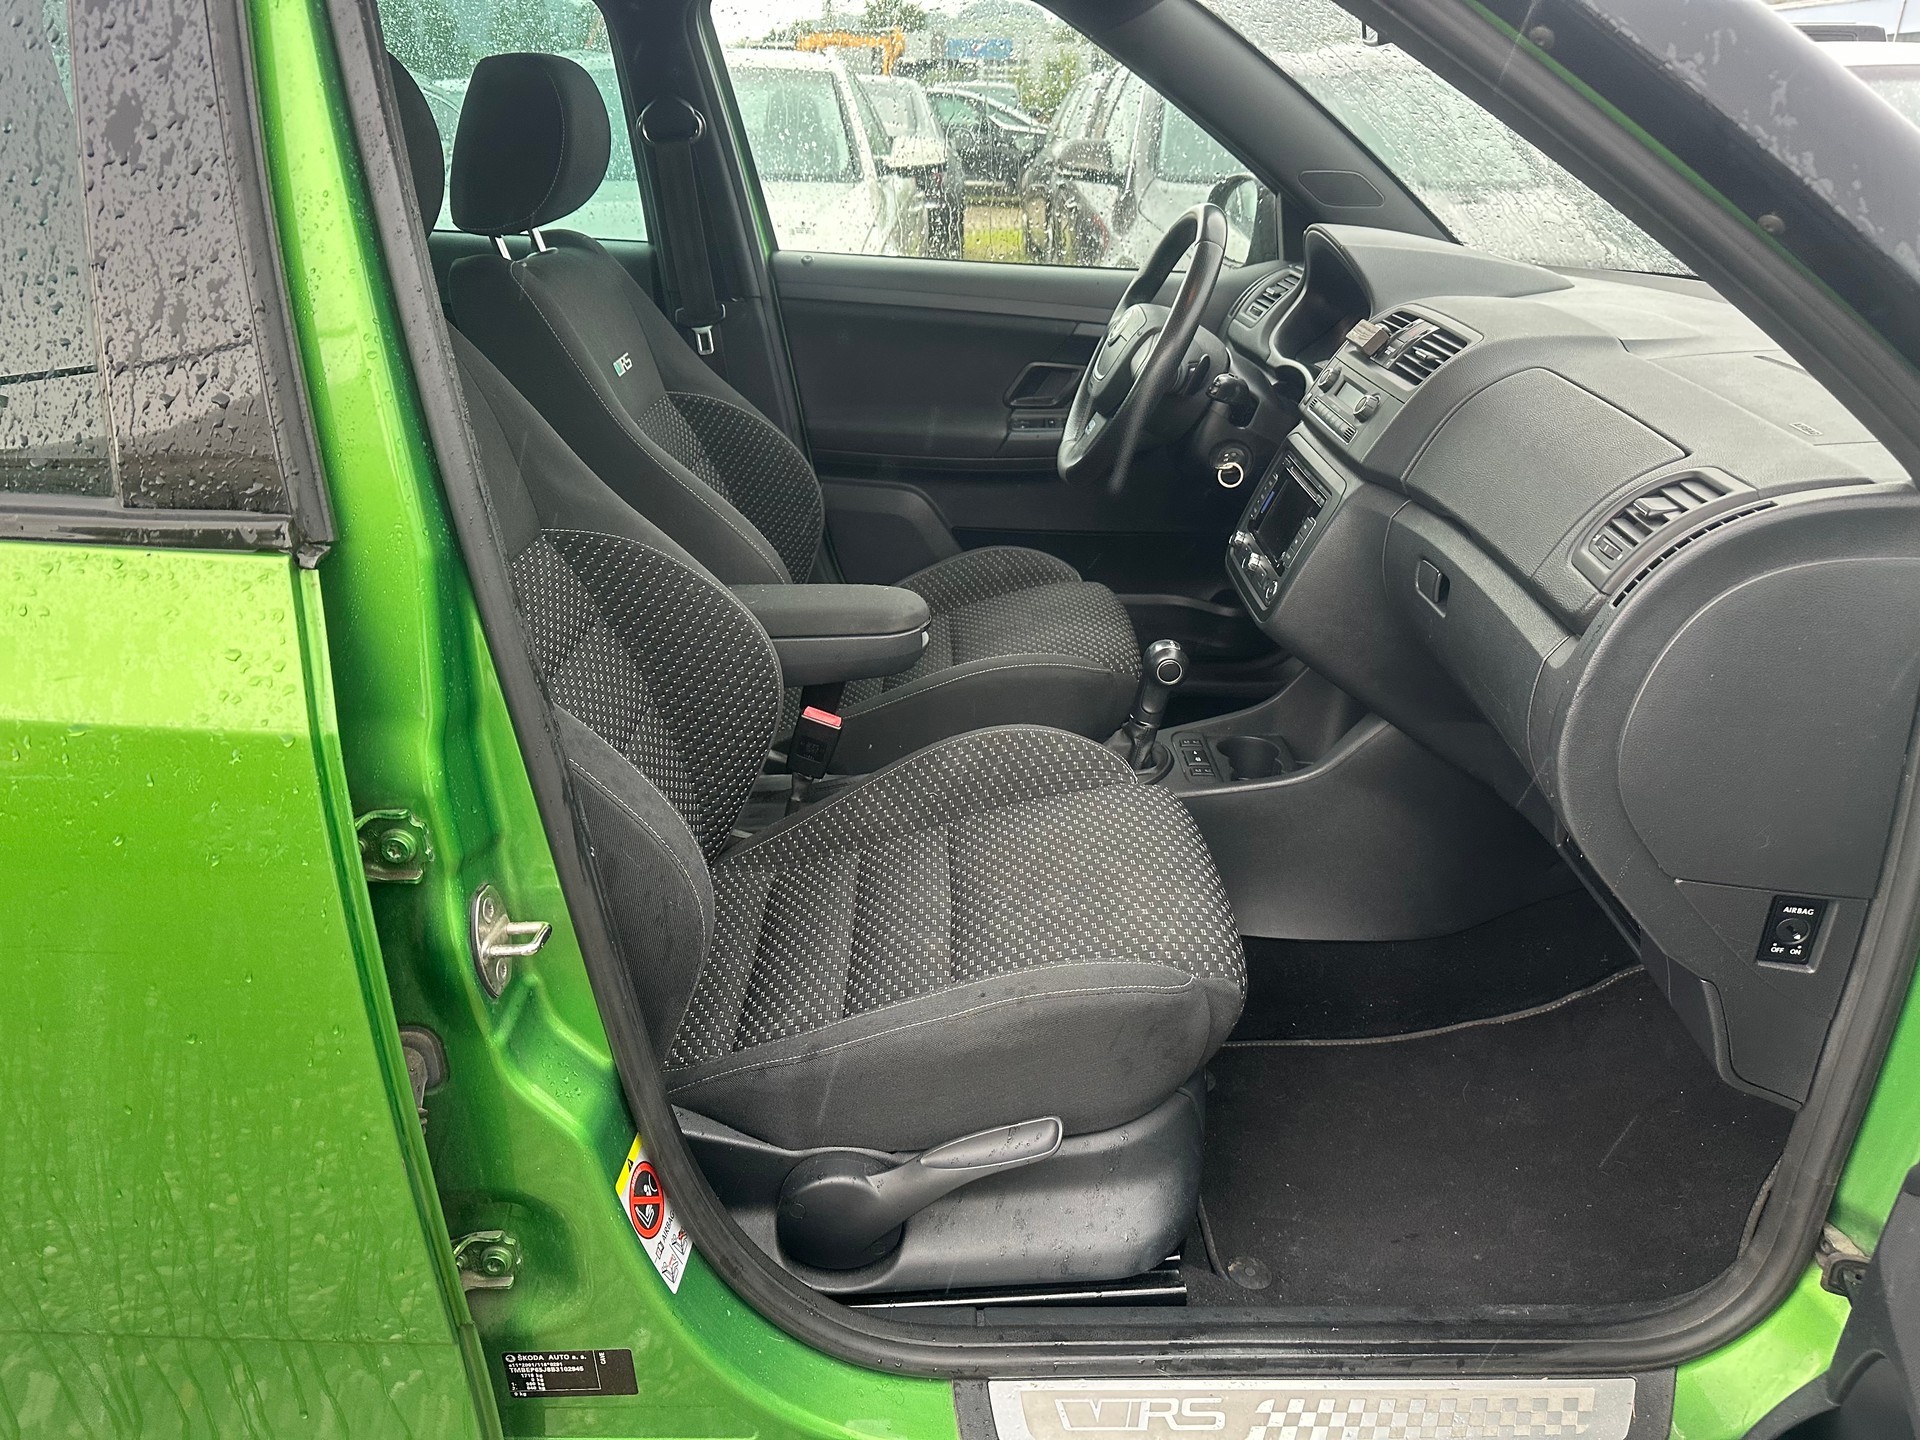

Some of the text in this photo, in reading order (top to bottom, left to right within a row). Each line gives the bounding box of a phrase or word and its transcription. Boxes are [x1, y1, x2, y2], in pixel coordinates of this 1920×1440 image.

[1782, 906, 1815, 916] AIRBAG
[1770, 946, 1802, 956] OFF ON
[662, 1211, 675, 1242] AIRBAG
